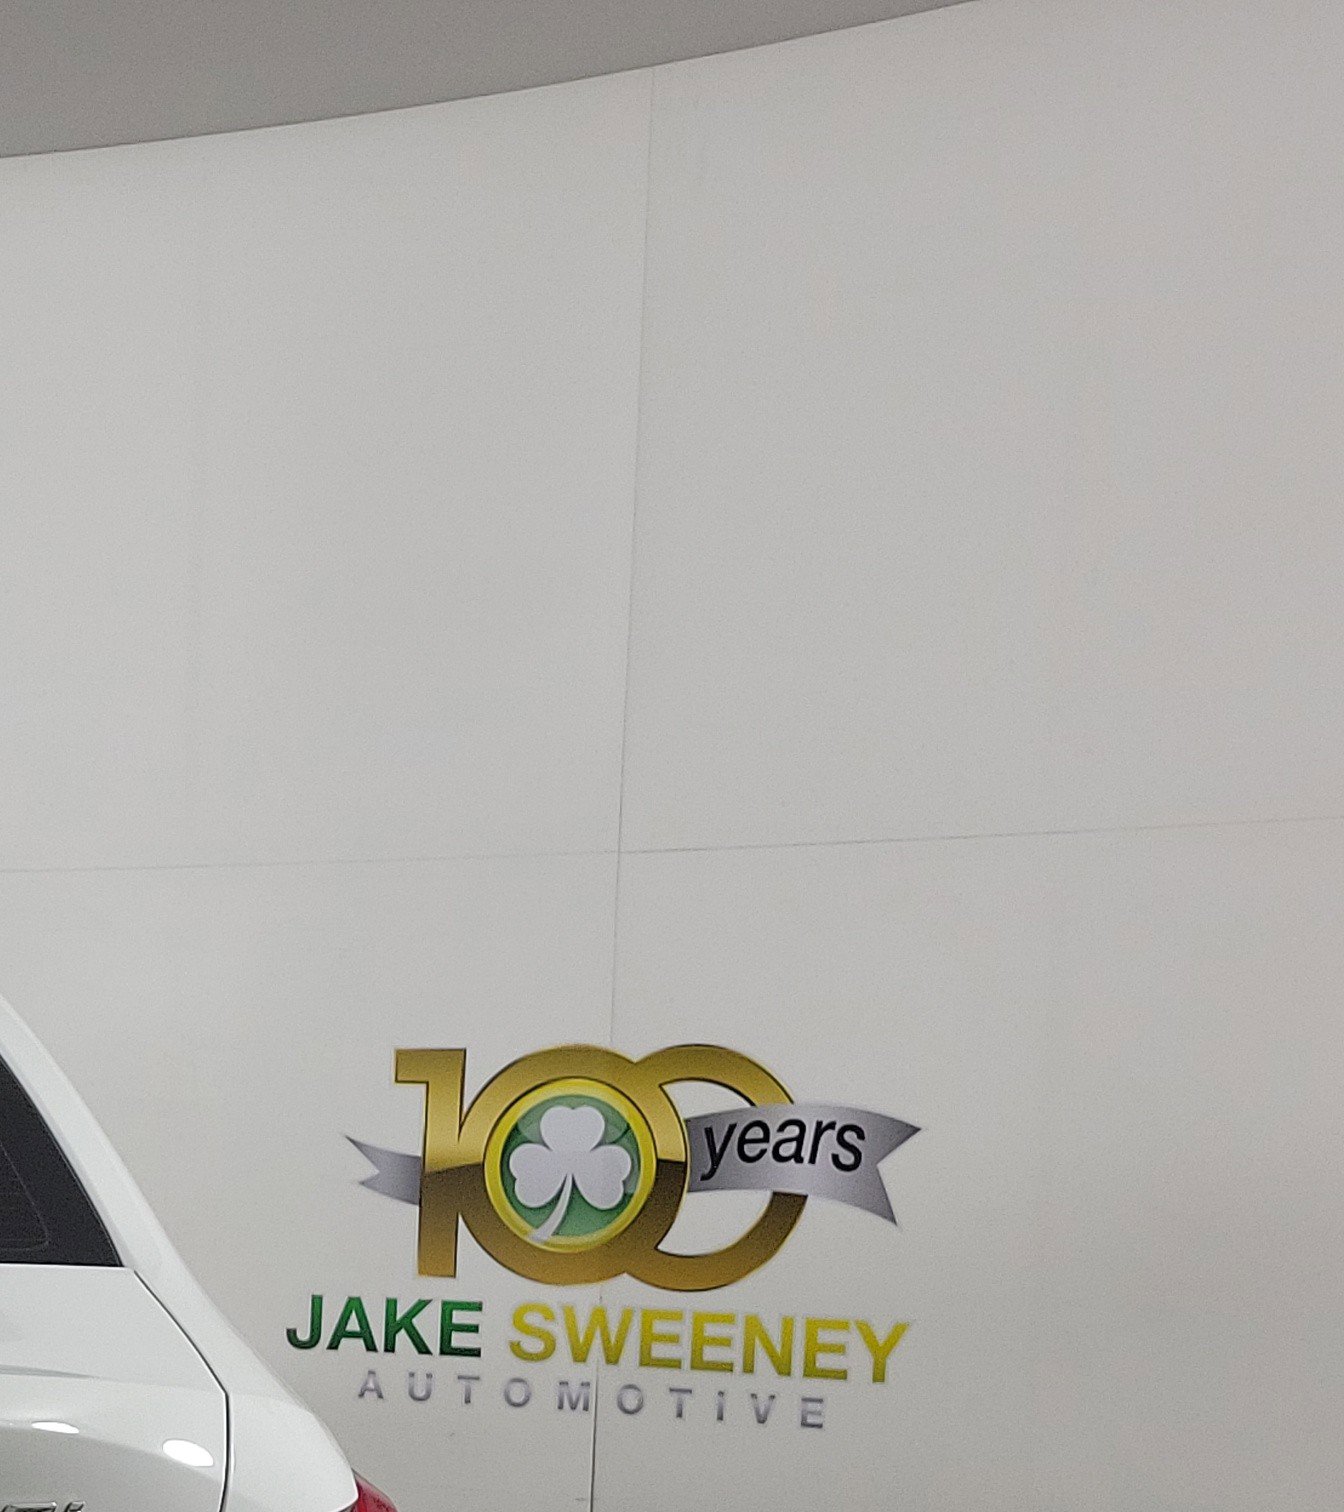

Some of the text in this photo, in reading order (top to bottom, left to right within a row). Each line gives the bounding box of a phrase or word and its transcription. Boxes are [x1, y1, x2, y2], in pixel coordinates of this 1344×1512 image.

[393, 1044, 808, 1292] 100
[700, 1117, 865, 1181] years
[286, 1294, 910, 1384] JAKE SWEENEY
[357, 1370, 825, 1430] AUTOMOTIVE
